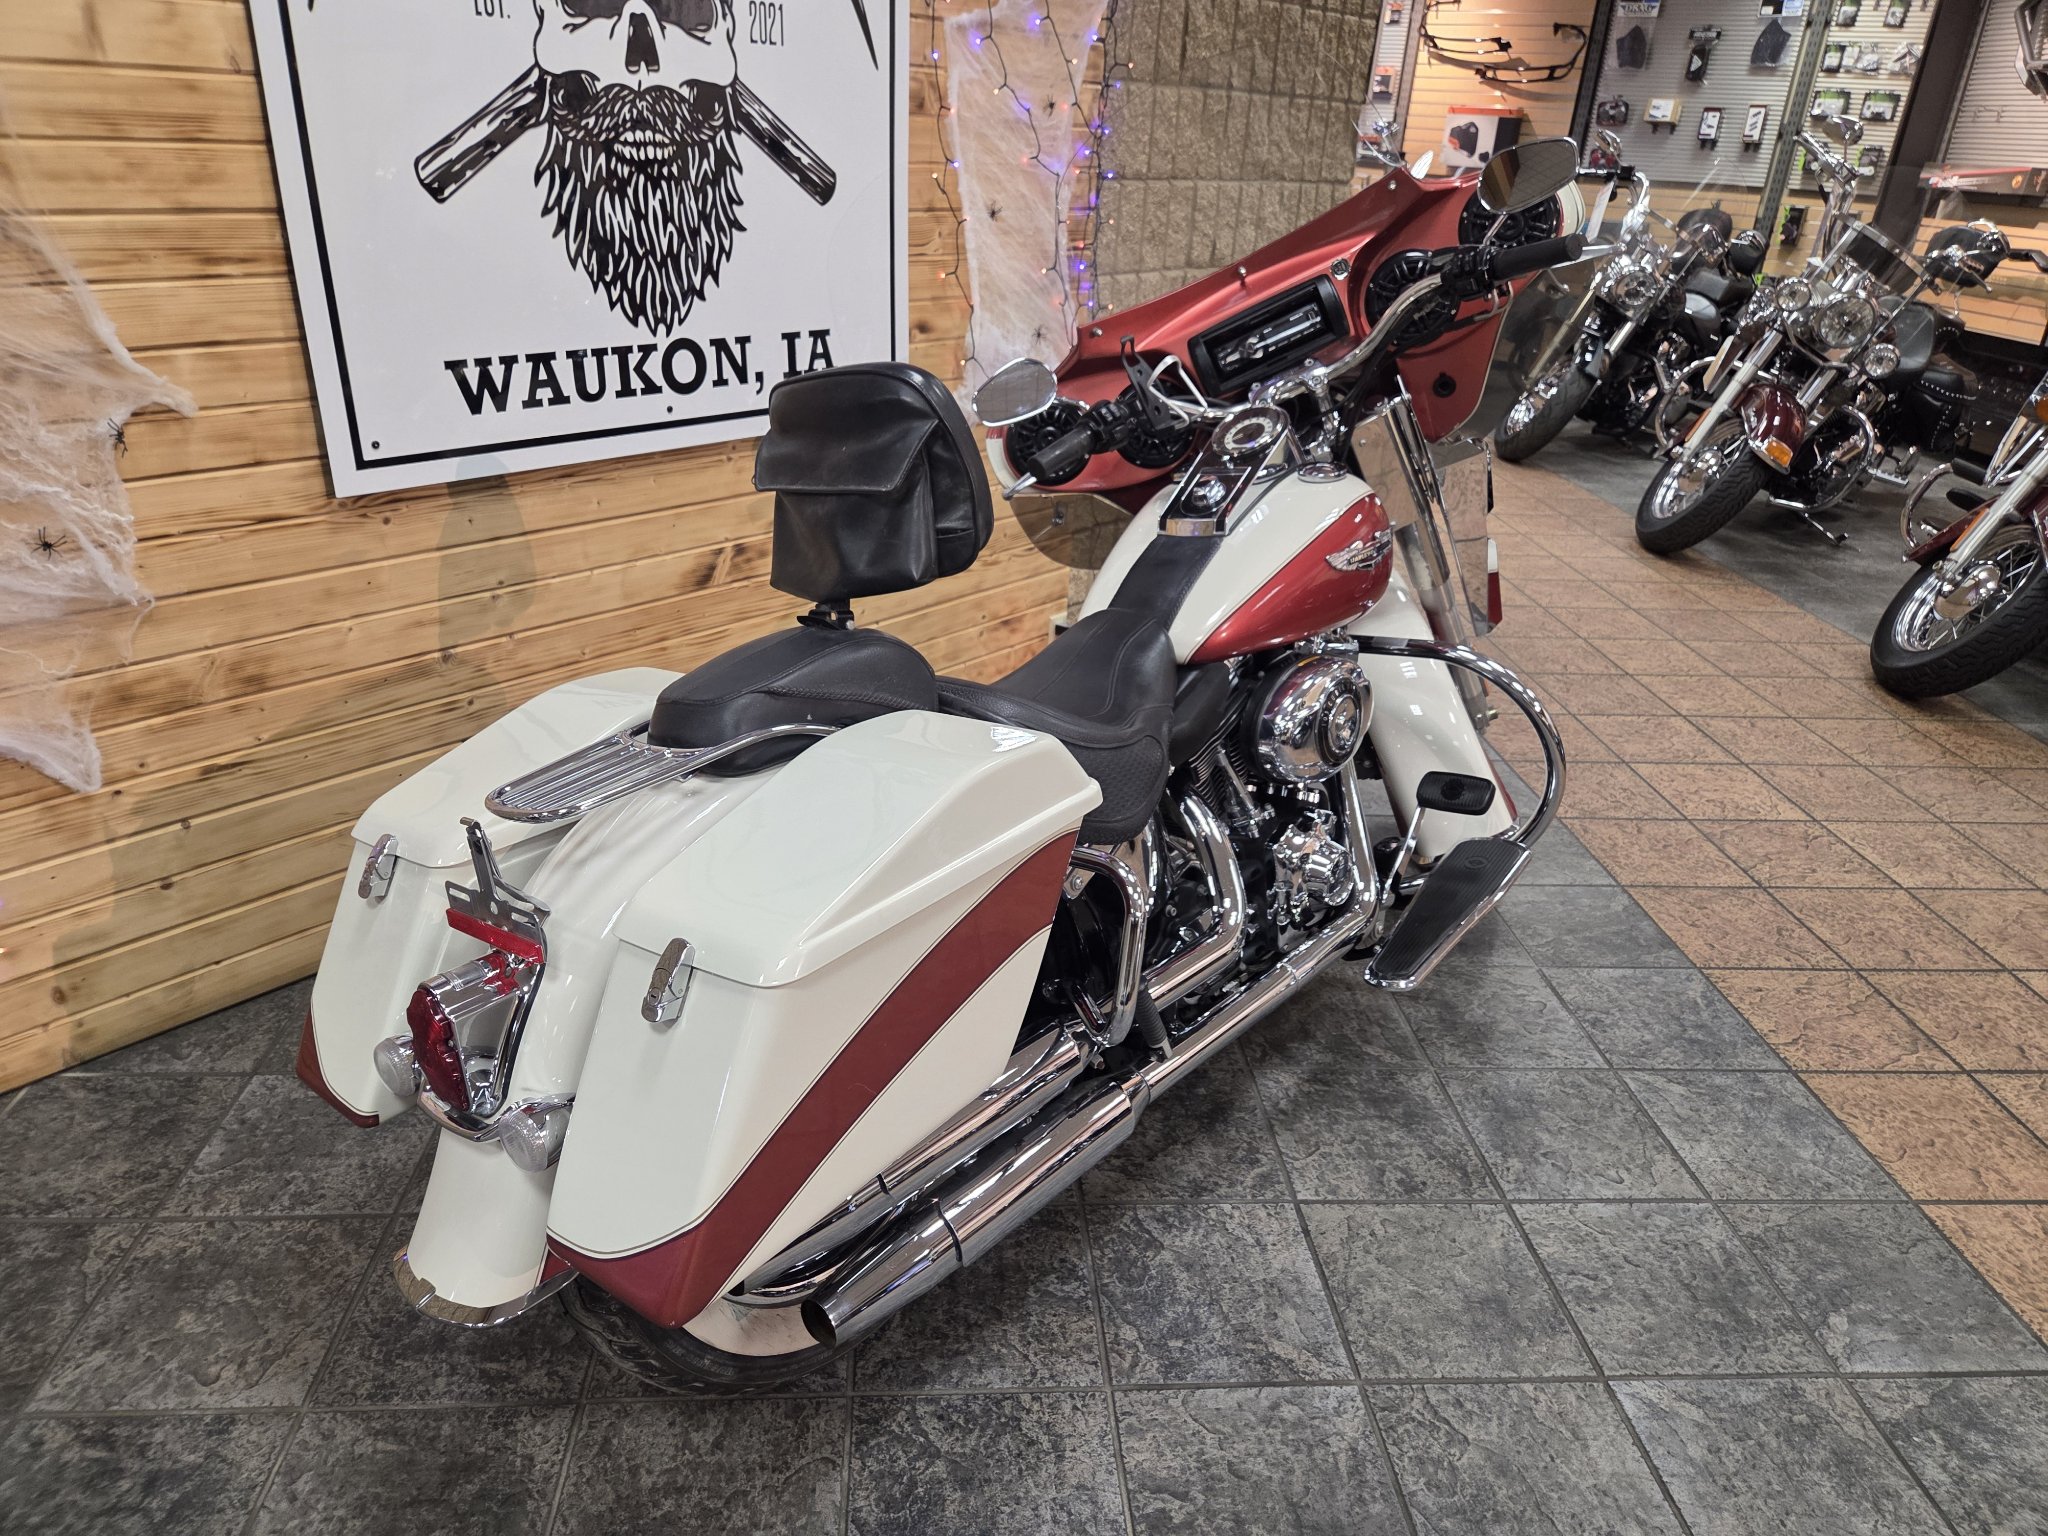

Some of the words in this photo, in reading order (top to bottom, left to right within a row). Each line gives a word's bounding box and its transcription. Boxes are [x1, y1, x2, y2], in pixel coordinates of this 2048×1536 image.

[749, 0, 784, 47] 2021
[444, 335, 764, 416] WAUKON,
[781, 329, 838, 379] IA
